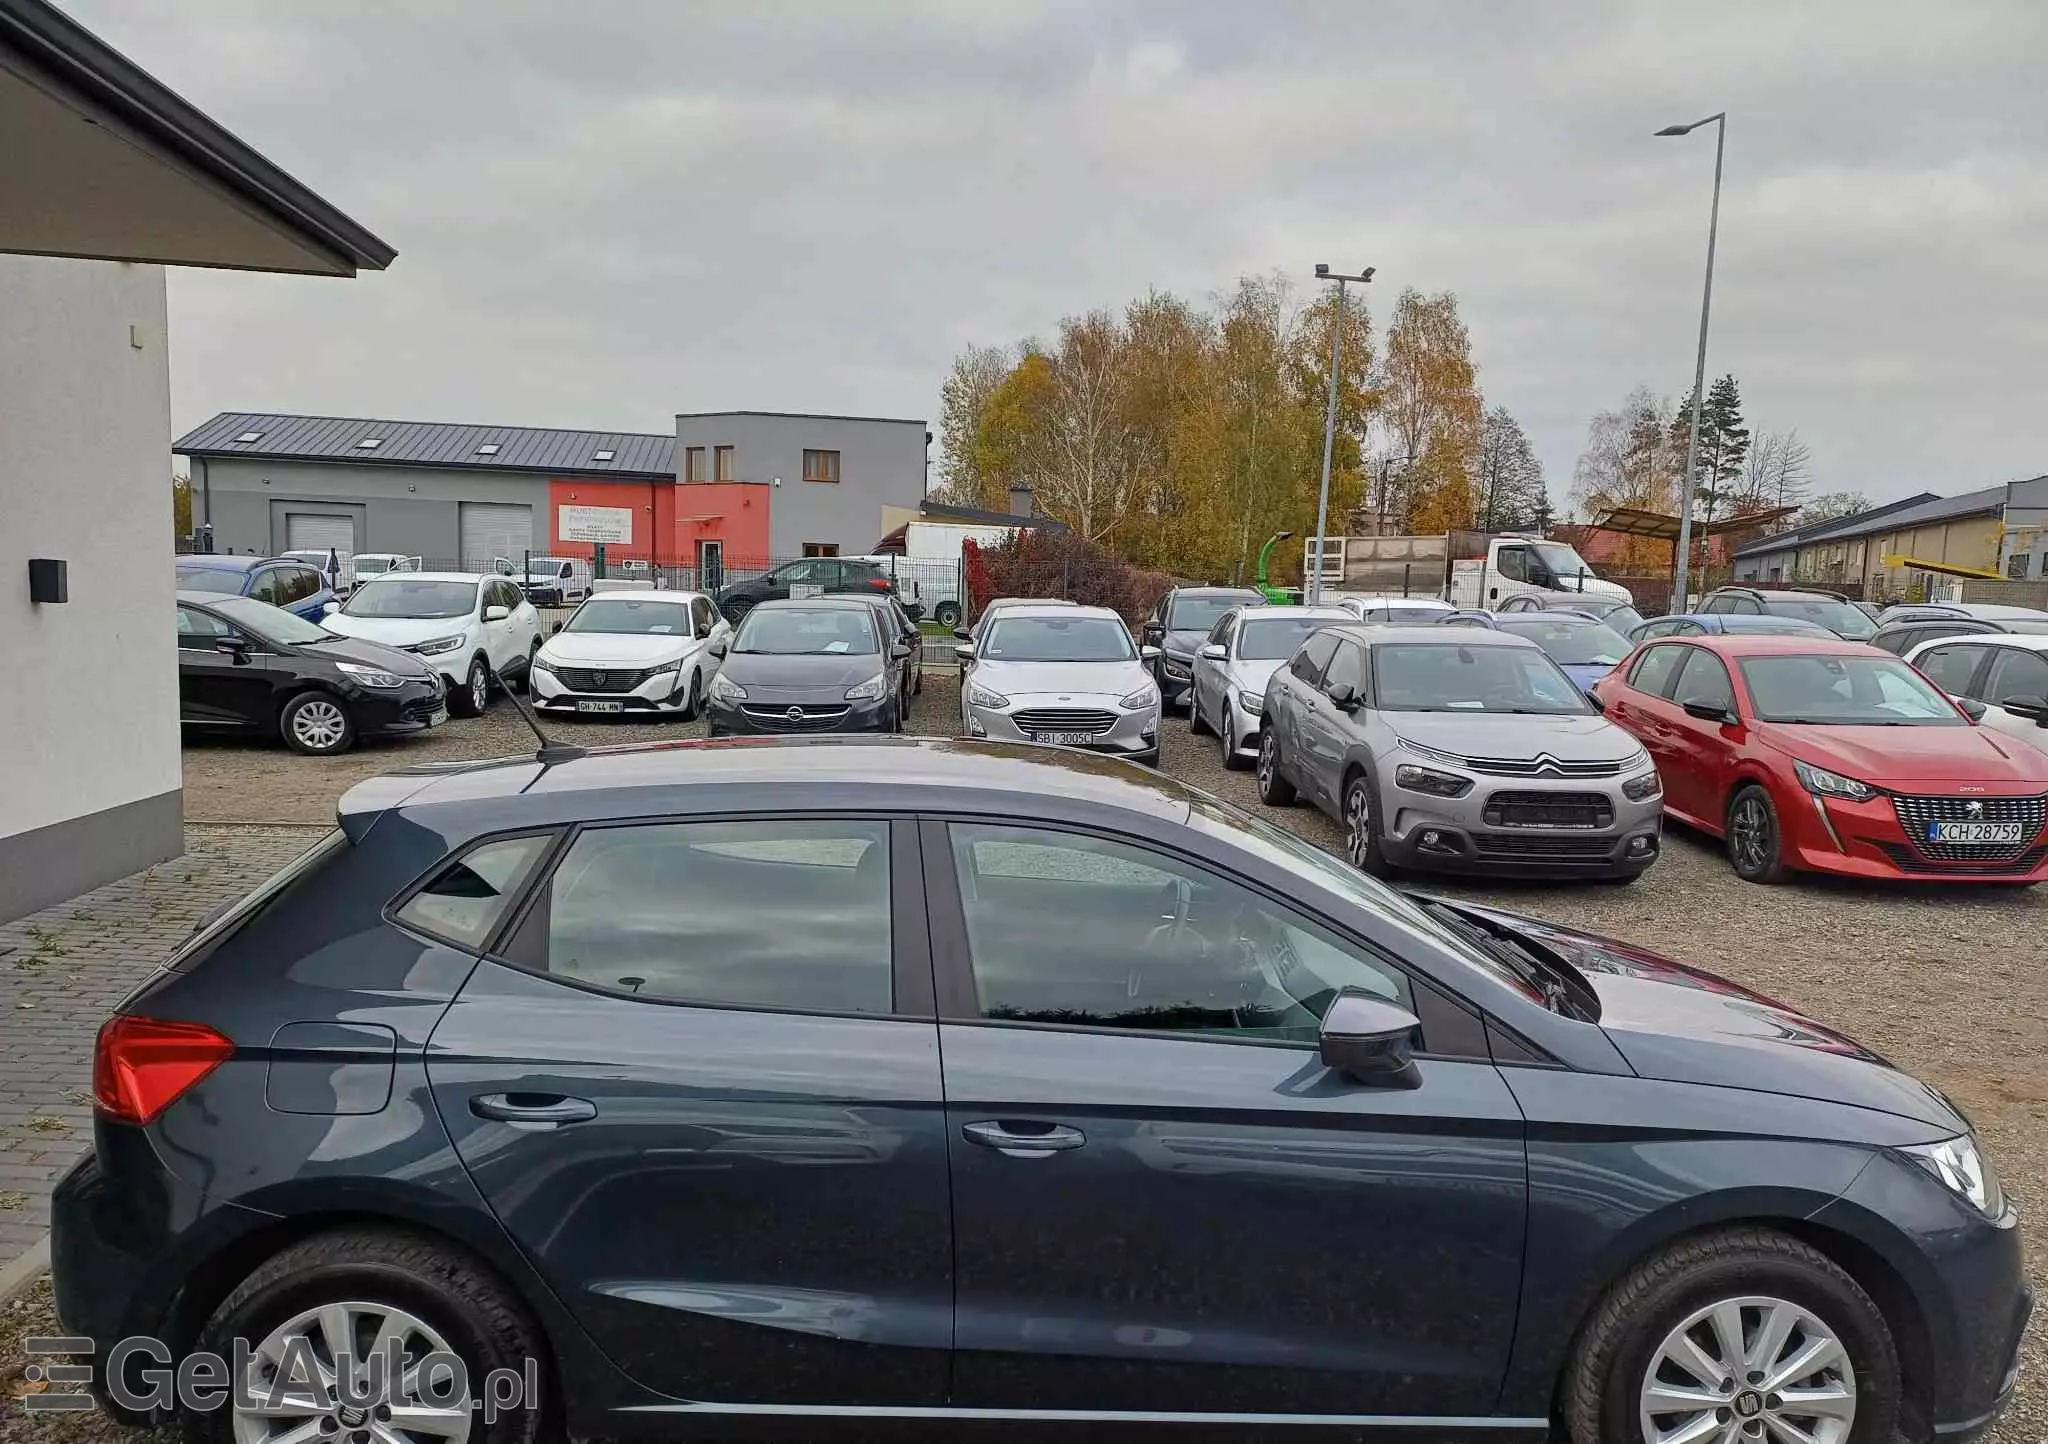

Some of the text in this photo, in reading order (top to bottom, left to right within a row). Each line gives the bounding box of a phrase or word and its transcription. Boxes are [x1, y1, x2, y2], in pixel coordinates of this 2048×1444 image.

[592, 702, 606, 712] 744
[1037, 733, 1090, 744] SBI 3005C
[1938, 824, 2020, 840] KCH 28759
